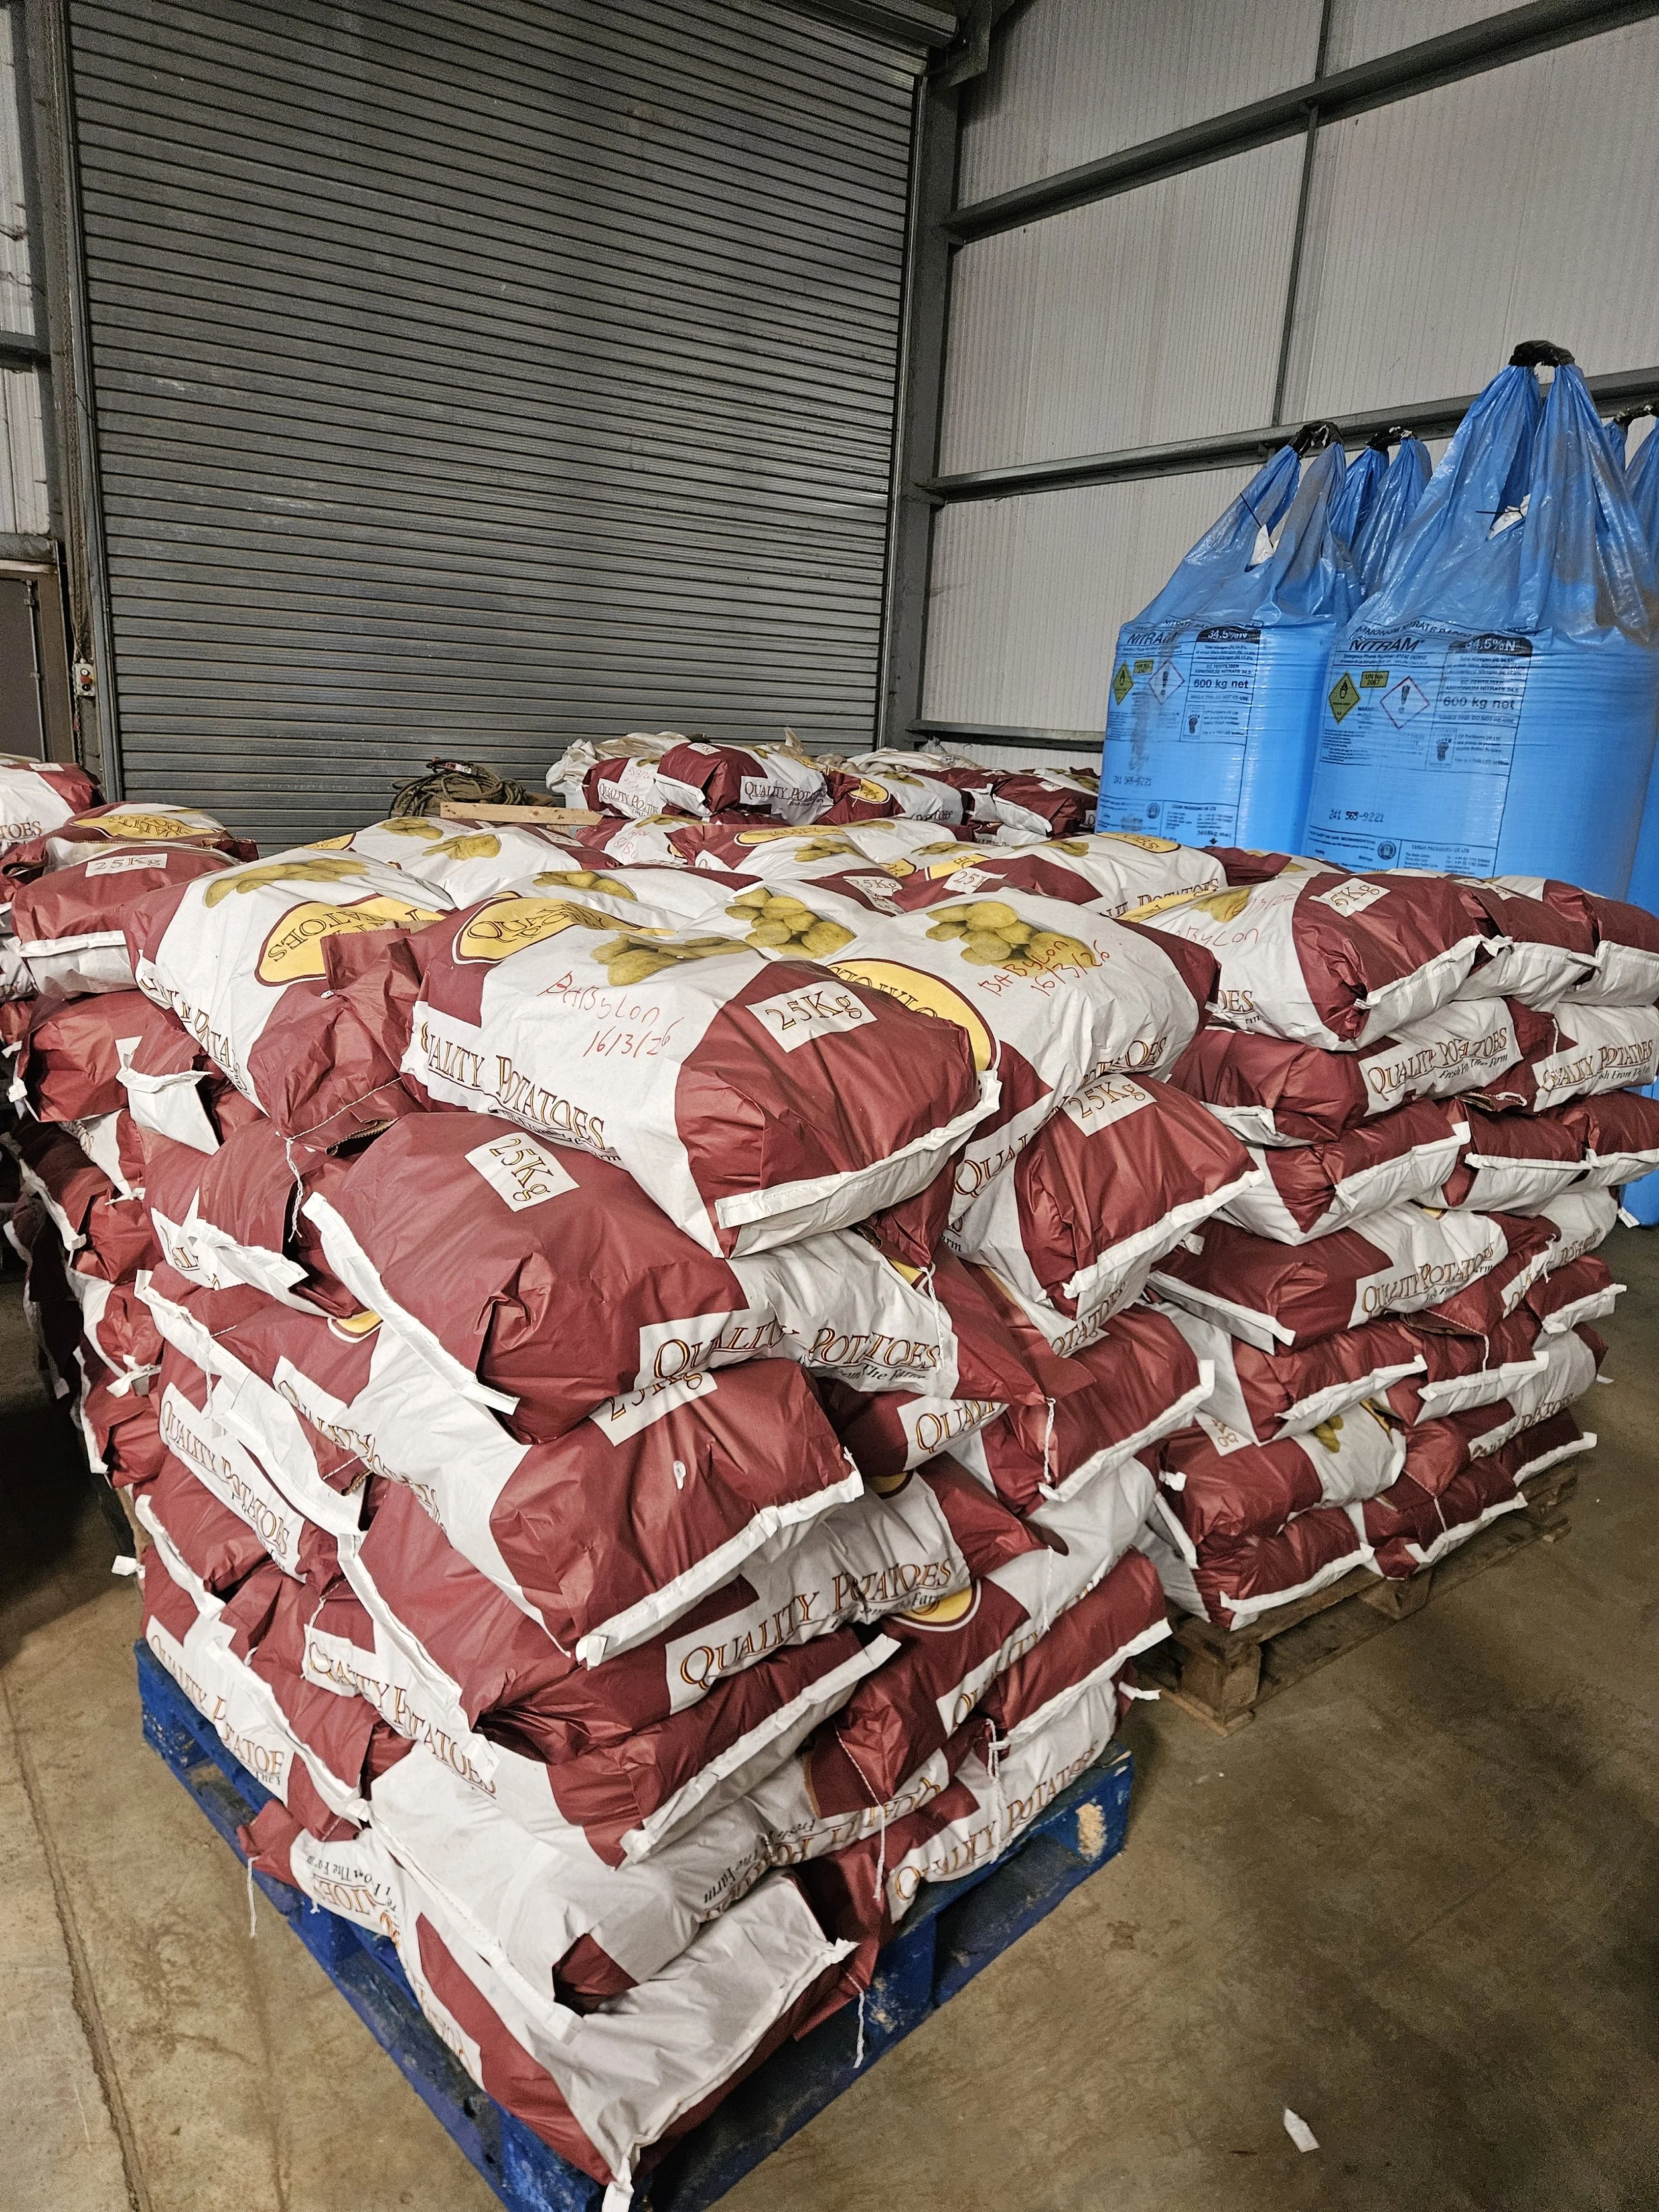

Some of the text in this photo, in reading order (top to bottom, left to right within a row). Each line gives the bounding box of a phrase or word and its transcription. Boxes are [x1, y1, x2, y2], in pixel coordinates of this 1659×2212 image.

[1349, 637, 1420, 651] NITRAM
[1194, 679, 1249, 690] 600 kg net
[1443, 696, 1467, 706] 600
[1472, 697, 1488, 709] kg
[745, 781, 788, 800] QUALITY
[94, 857, 163, 871] 25Kg
[1330, 883, 1380, 908] 5Kg
[764, 988, 864, 1031] 25Kg
[1598, 1039, 1654, 1071] POTATOES
[495, 1055, 607, 1152] POTATOES
[1068, 1080, 1147, 1119] 25Kg
[490, 1137, 551, 1203] 25Kg
[809, 1327, 942, 1370] POTTOES
[162, 1400, 217, 1473] QUALITY
[680, 1591, 820, 1691] QUALITY
